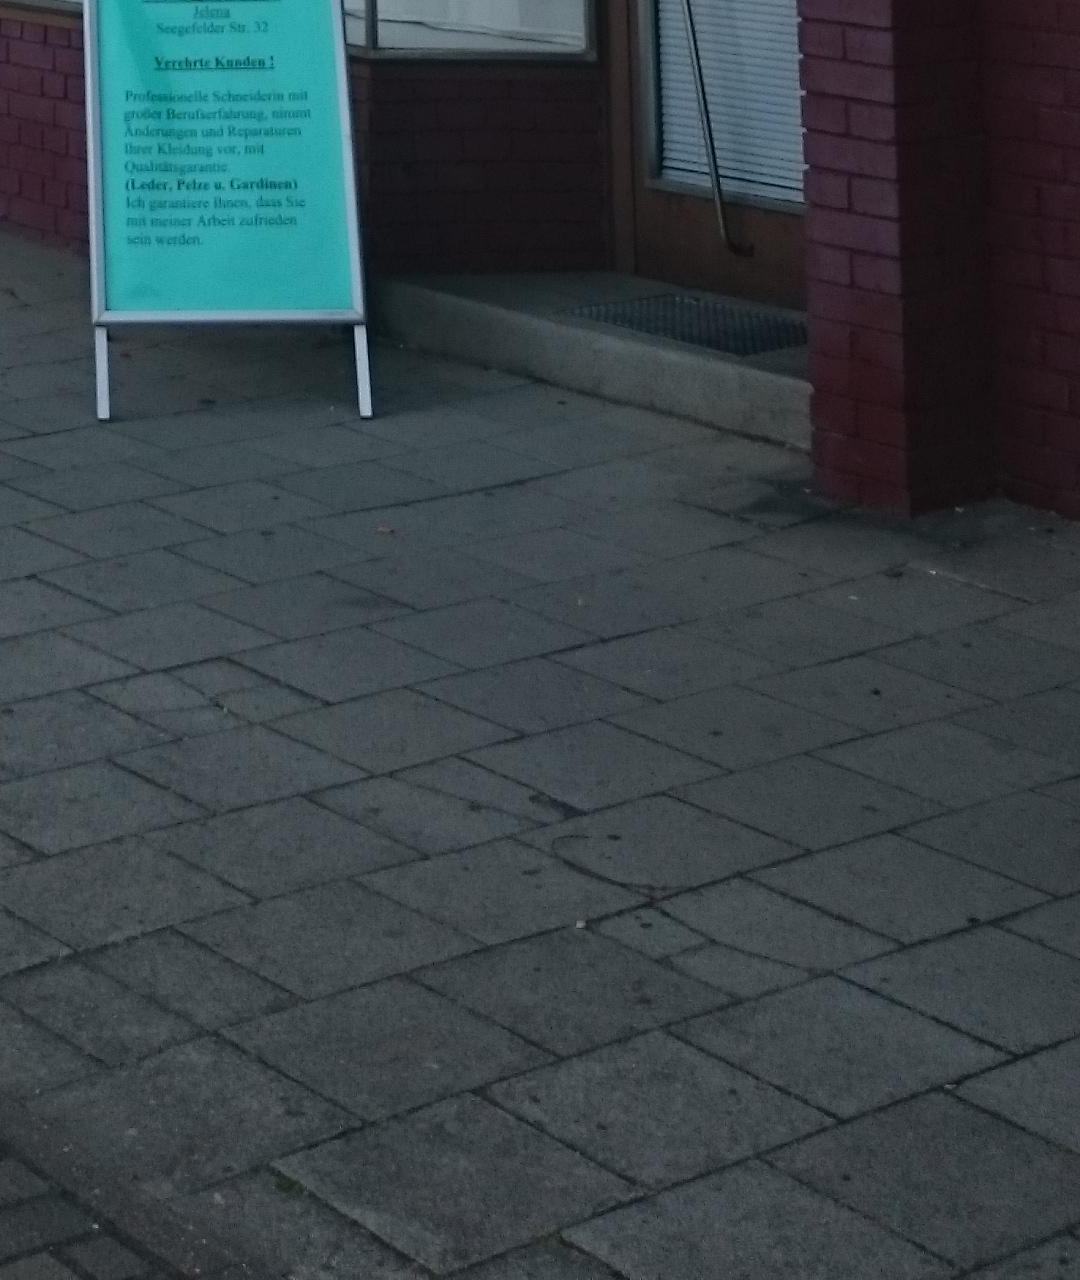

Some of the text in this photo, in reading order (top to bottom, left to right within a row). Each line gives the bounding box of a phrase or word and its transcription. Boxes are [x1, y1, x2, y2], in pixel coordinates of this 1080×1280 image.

[156, 21, 269, 37] Seegefelder Str. 32
[154, 56, 210, 71] Verehrte
[215, 56, 266, 70] Kunden
[157, 143, 213, 158] Kleidung
[244, 143, 264, 155] mit
[177, 178, 210, 191] Pelze
[230, 178, 298, 191] Gardinen)
